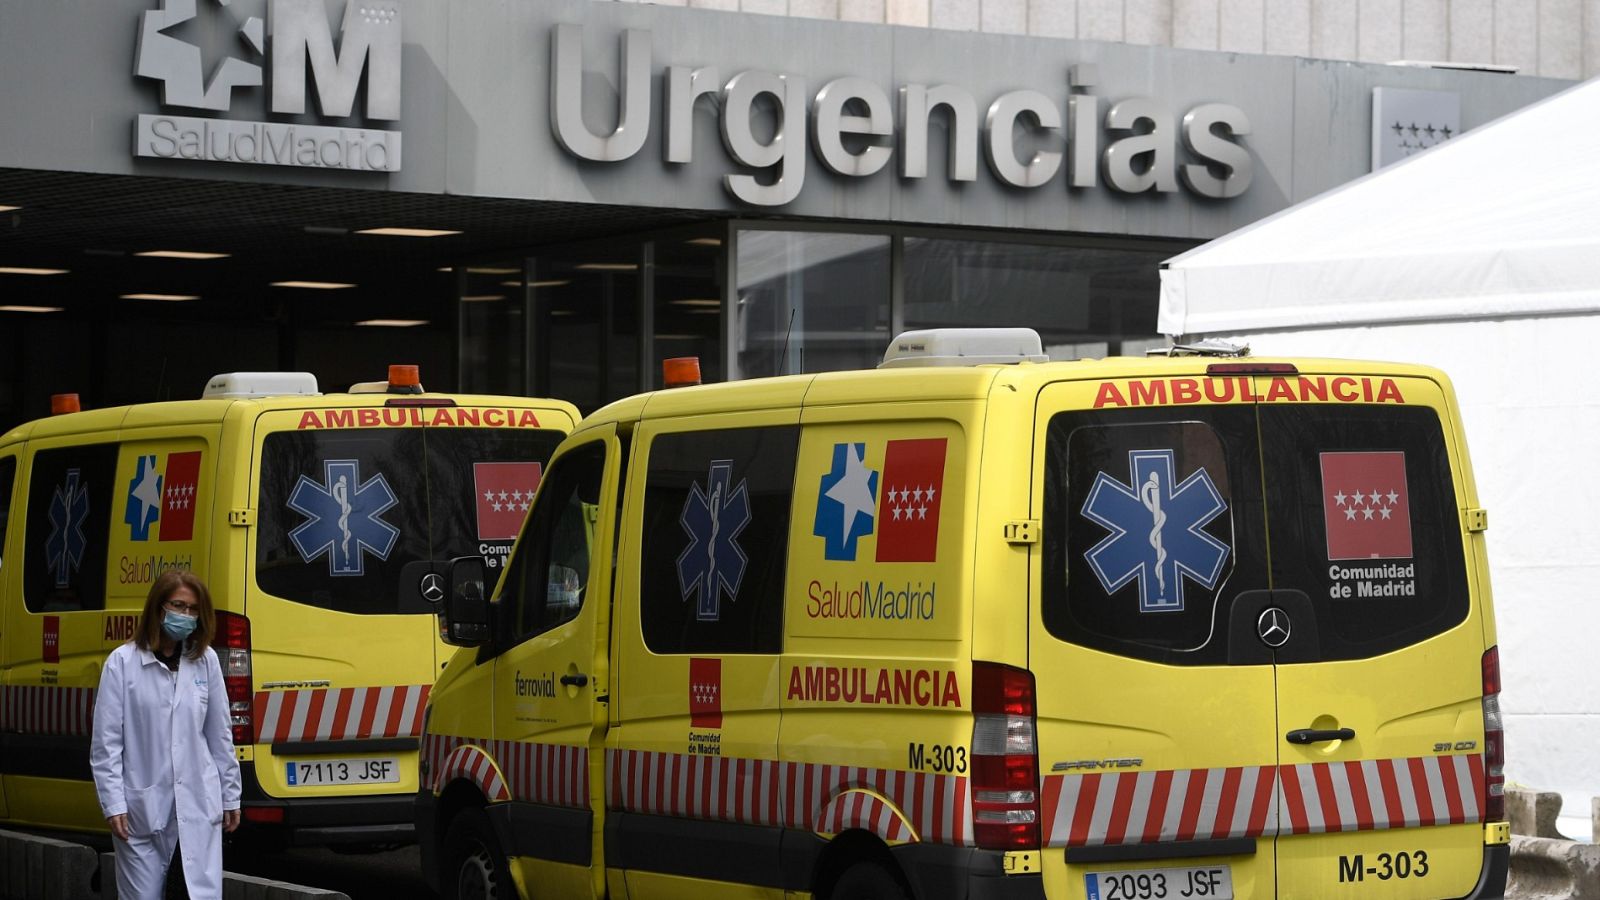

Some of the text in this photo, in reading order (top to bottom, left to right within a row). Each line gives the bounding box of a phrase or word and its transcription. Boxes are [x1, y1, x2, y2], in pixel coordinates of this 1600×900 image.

[549, 22, 1253, 207] Urgencias
[150, 117, 394, 171] SaludMadrid
[1093, 376, 1406, 409] AMBULANCIA
[297, 407, 541, 431] AMBULANCIA
[1328, 563, 1415, 580] Comunidad
[807, 579, 936, 621] SaludMadrid
[1329, 580, 1416, 599] de Madrid
[515, 669, 556, 698] ferrovial
[787, 665, 962, 708] AMBULANCIA
[688, 731, 721, 743] Comunidad
[688, 743, 721, 755] de Madrid
[300, 762, 349, 784] 7113
[359, 760, 392, 780] JSF
[908, 742, 968, 774] M-303
[1339, 849, 1429, 883] M-303
[1104, 873, 1168, 900] 2093
[1180, 869, 1223, 897] JSF
